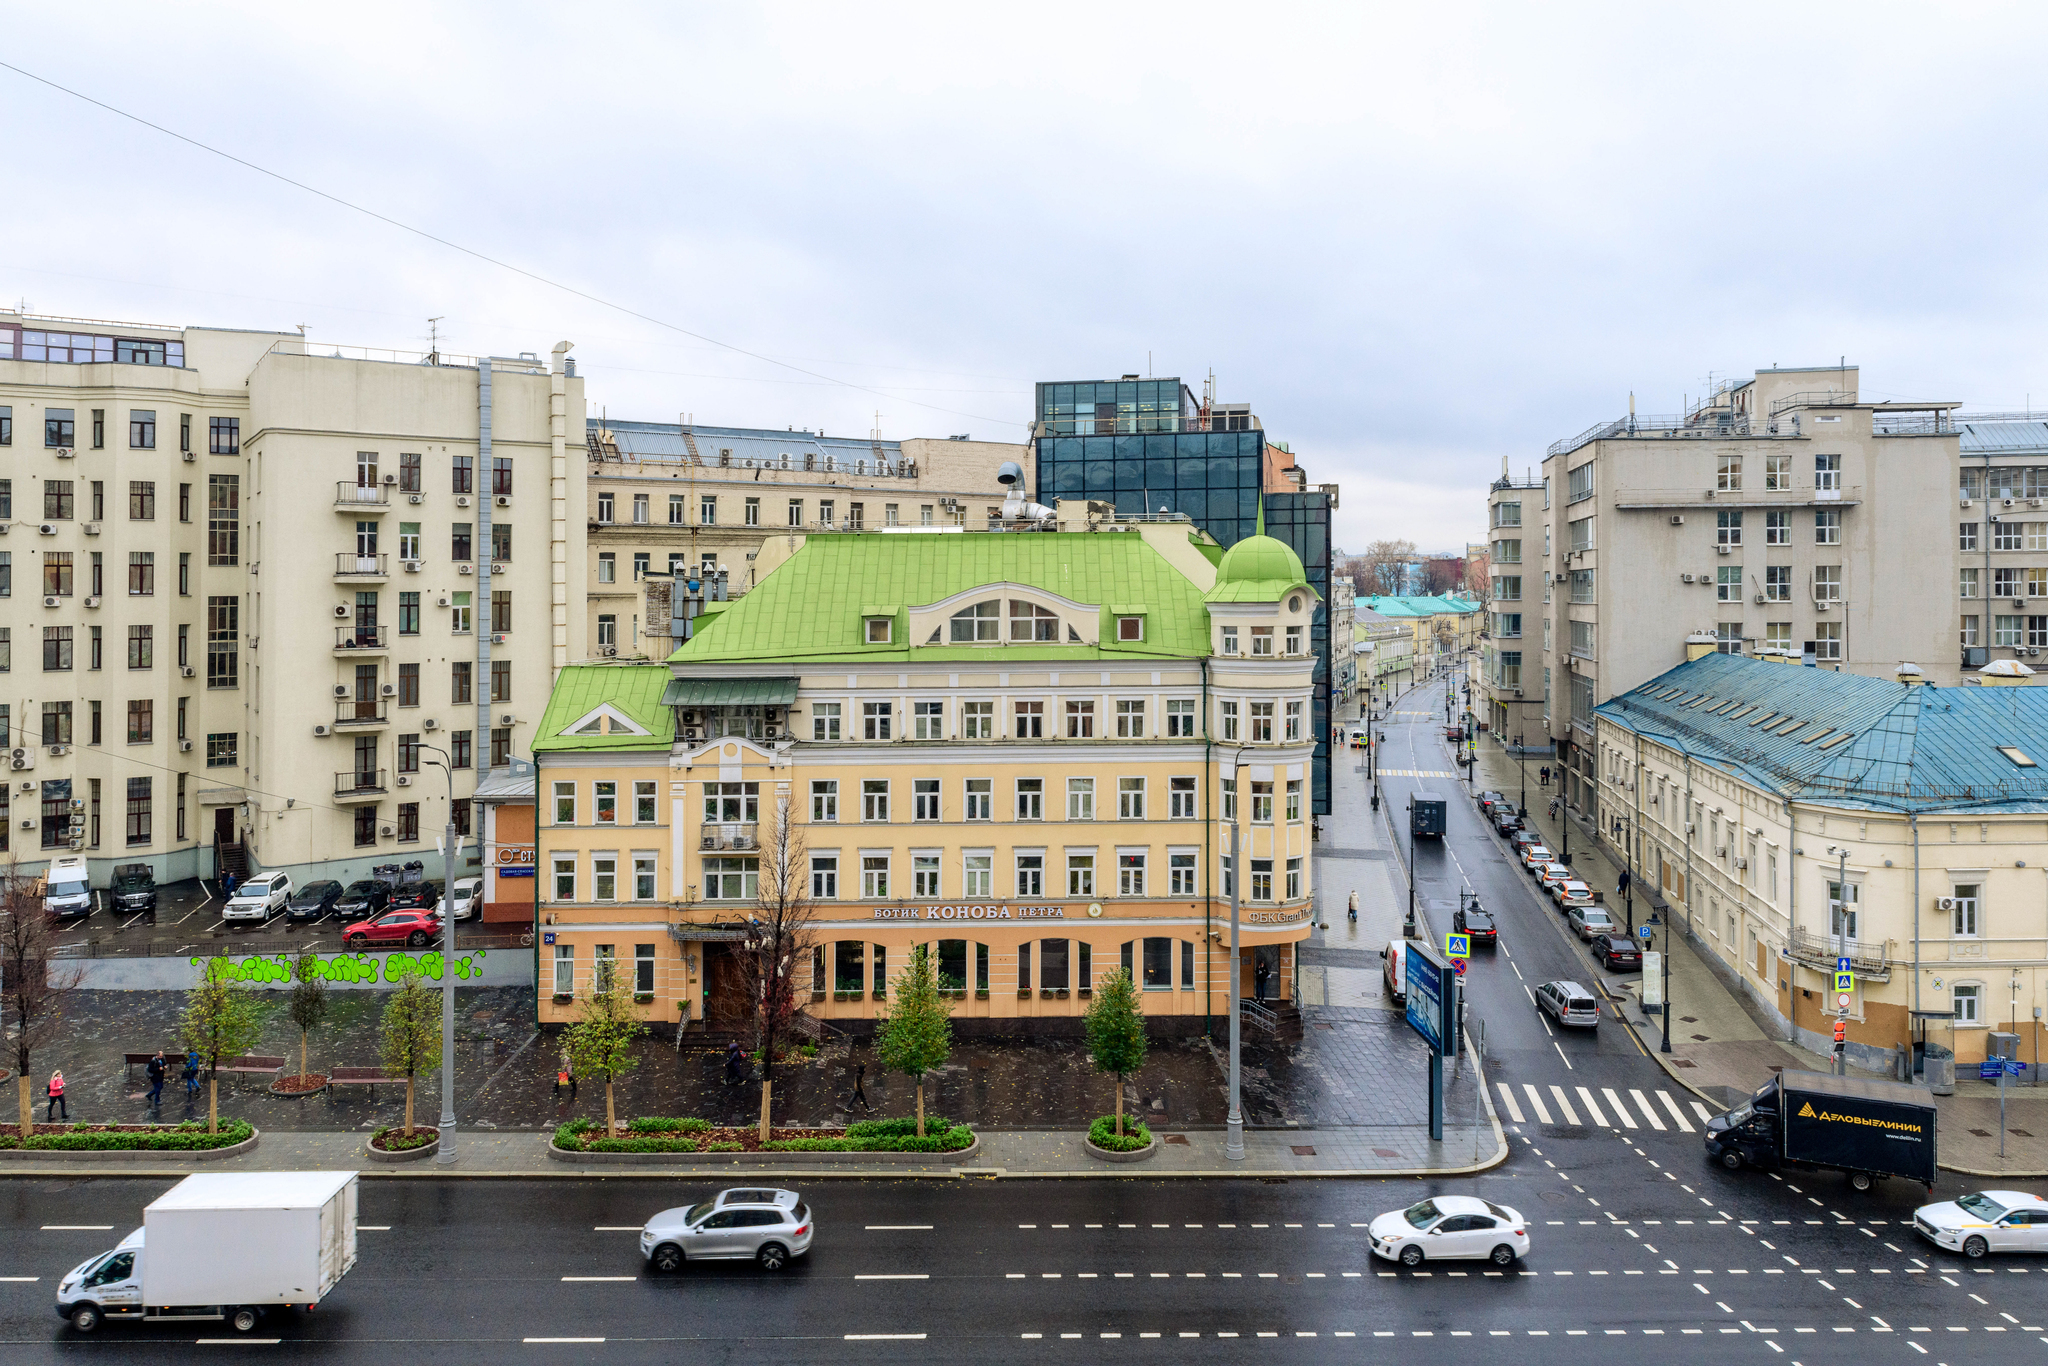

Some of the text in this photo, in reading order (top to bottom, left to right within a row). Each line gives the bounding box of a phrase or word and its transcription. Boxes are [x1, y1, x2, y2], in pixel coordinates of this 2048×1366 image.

[874, 906, 1063, 919] БОТИК КОНОБА ПЕТРА
[1249, 912, 1276, 923] ФБК
[1277, 911, 1302, 923] Grant
